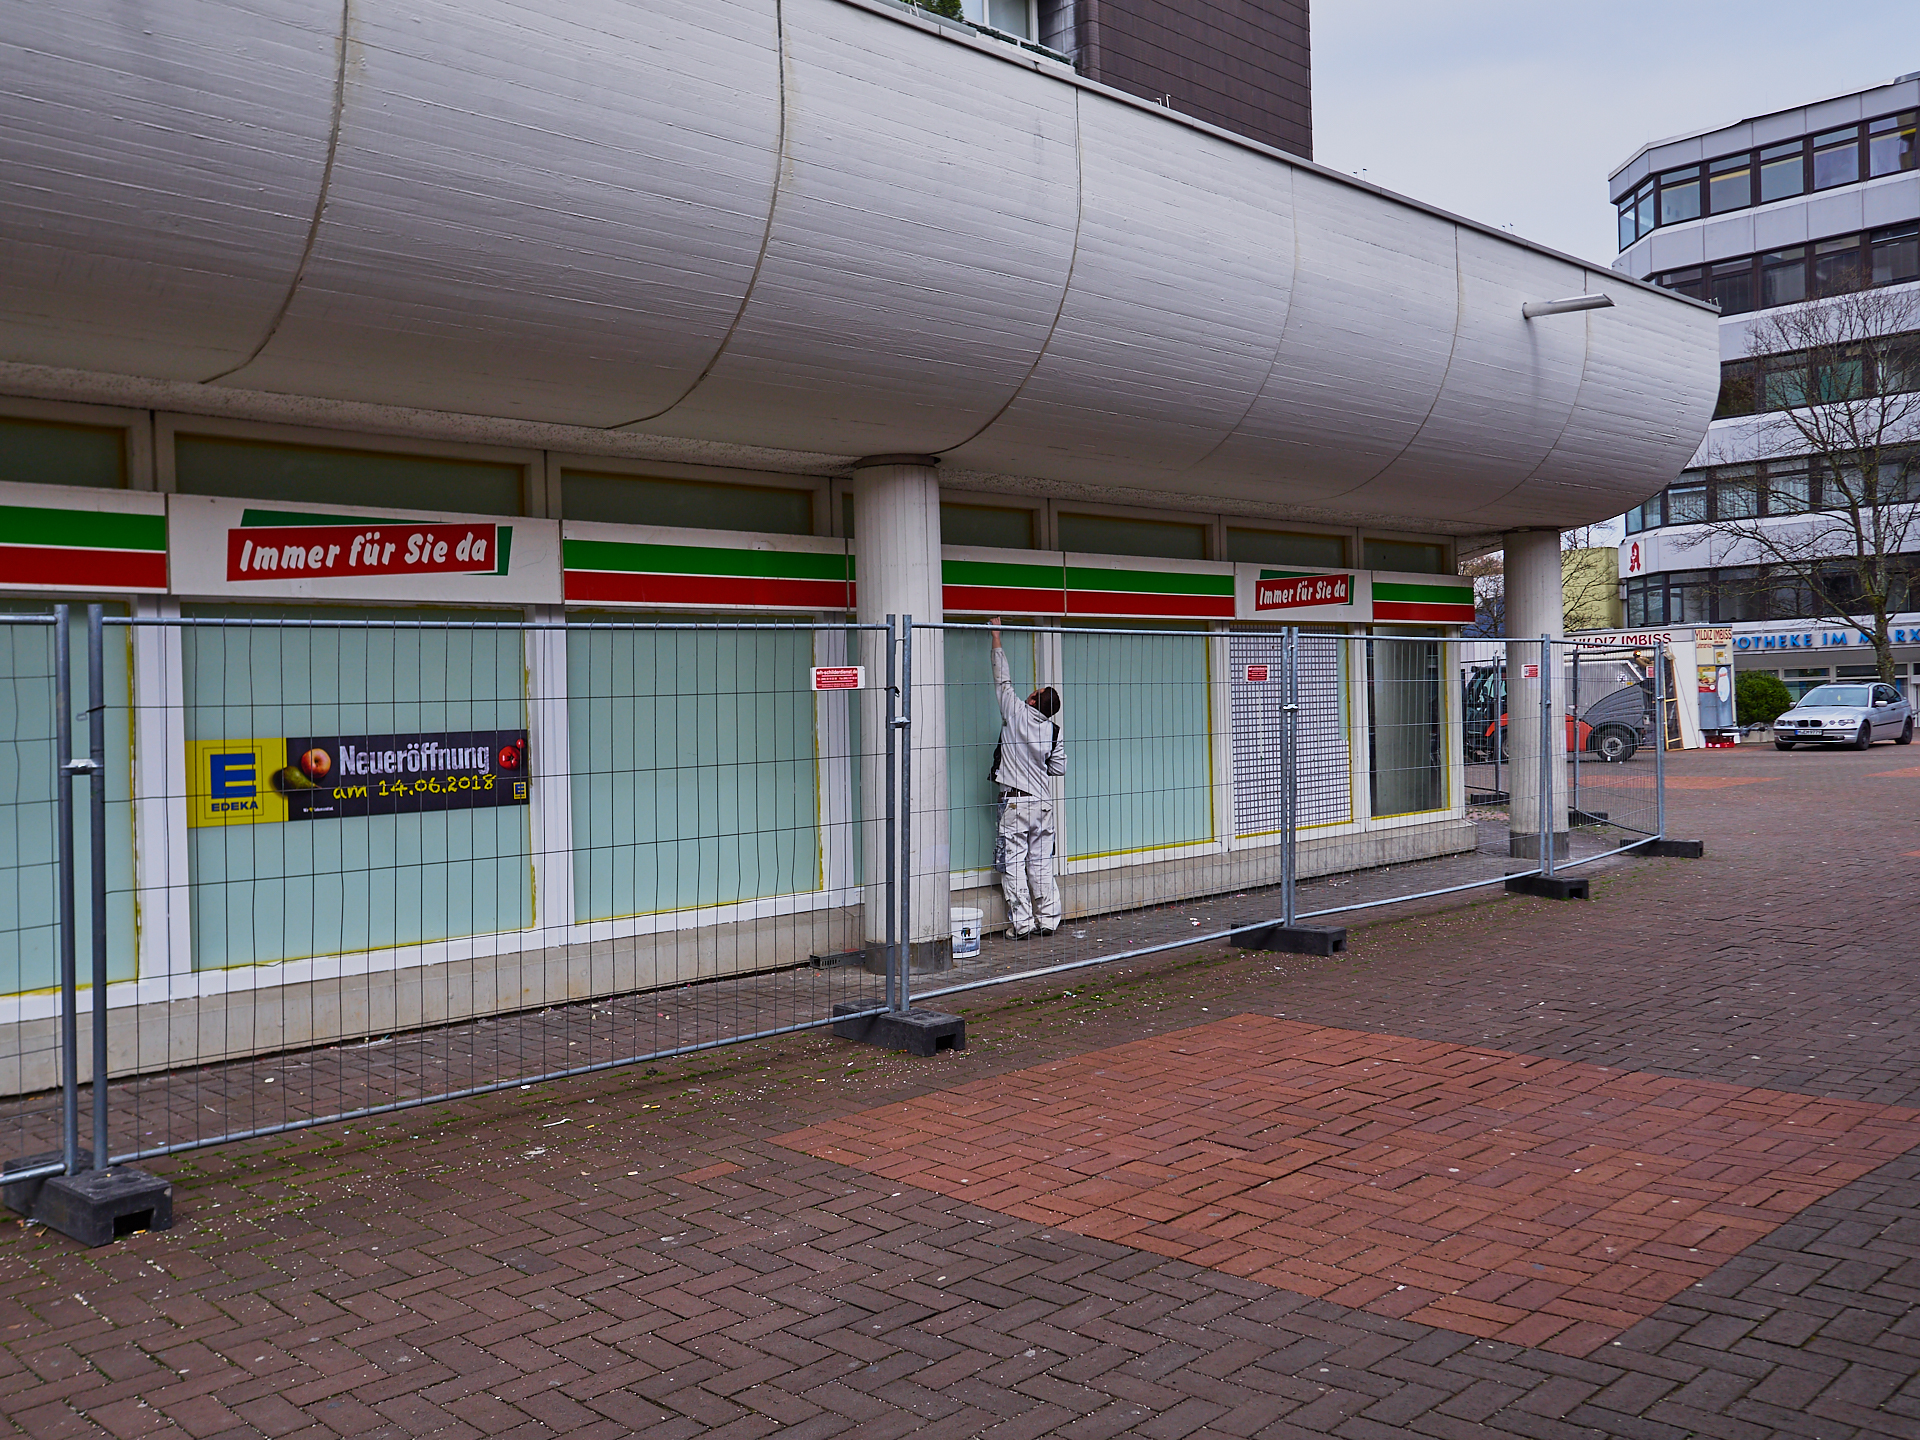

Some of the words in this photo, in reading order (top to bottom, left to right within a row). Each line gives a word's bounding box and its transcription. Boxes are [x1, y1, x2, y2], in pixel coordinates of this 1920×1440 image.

[239, 540, 340, 573] Immer
[349, 531, 396, 567] für
[404, 532, 449, 565] Sie
[455, 531, 488, 563] da
[1259, 586, 1294, 606] Immer
[1296, 580, 1314, 602] für
[1315, 580, 1332, 599] Sie
[1334, 579, 1346, 598] da
[1621, 632, 1672, 646] IMBISS
[1713, 629, 1732, 640] IMBISS
[1822, 631, 1848, 646] IM
[339, 741, 490, 776] Neueröffnung
[333, 784, 368, 800] am
[378, 773, 497, 798] 14.06.2018
[211, 801, 259, 812] EDEKA
